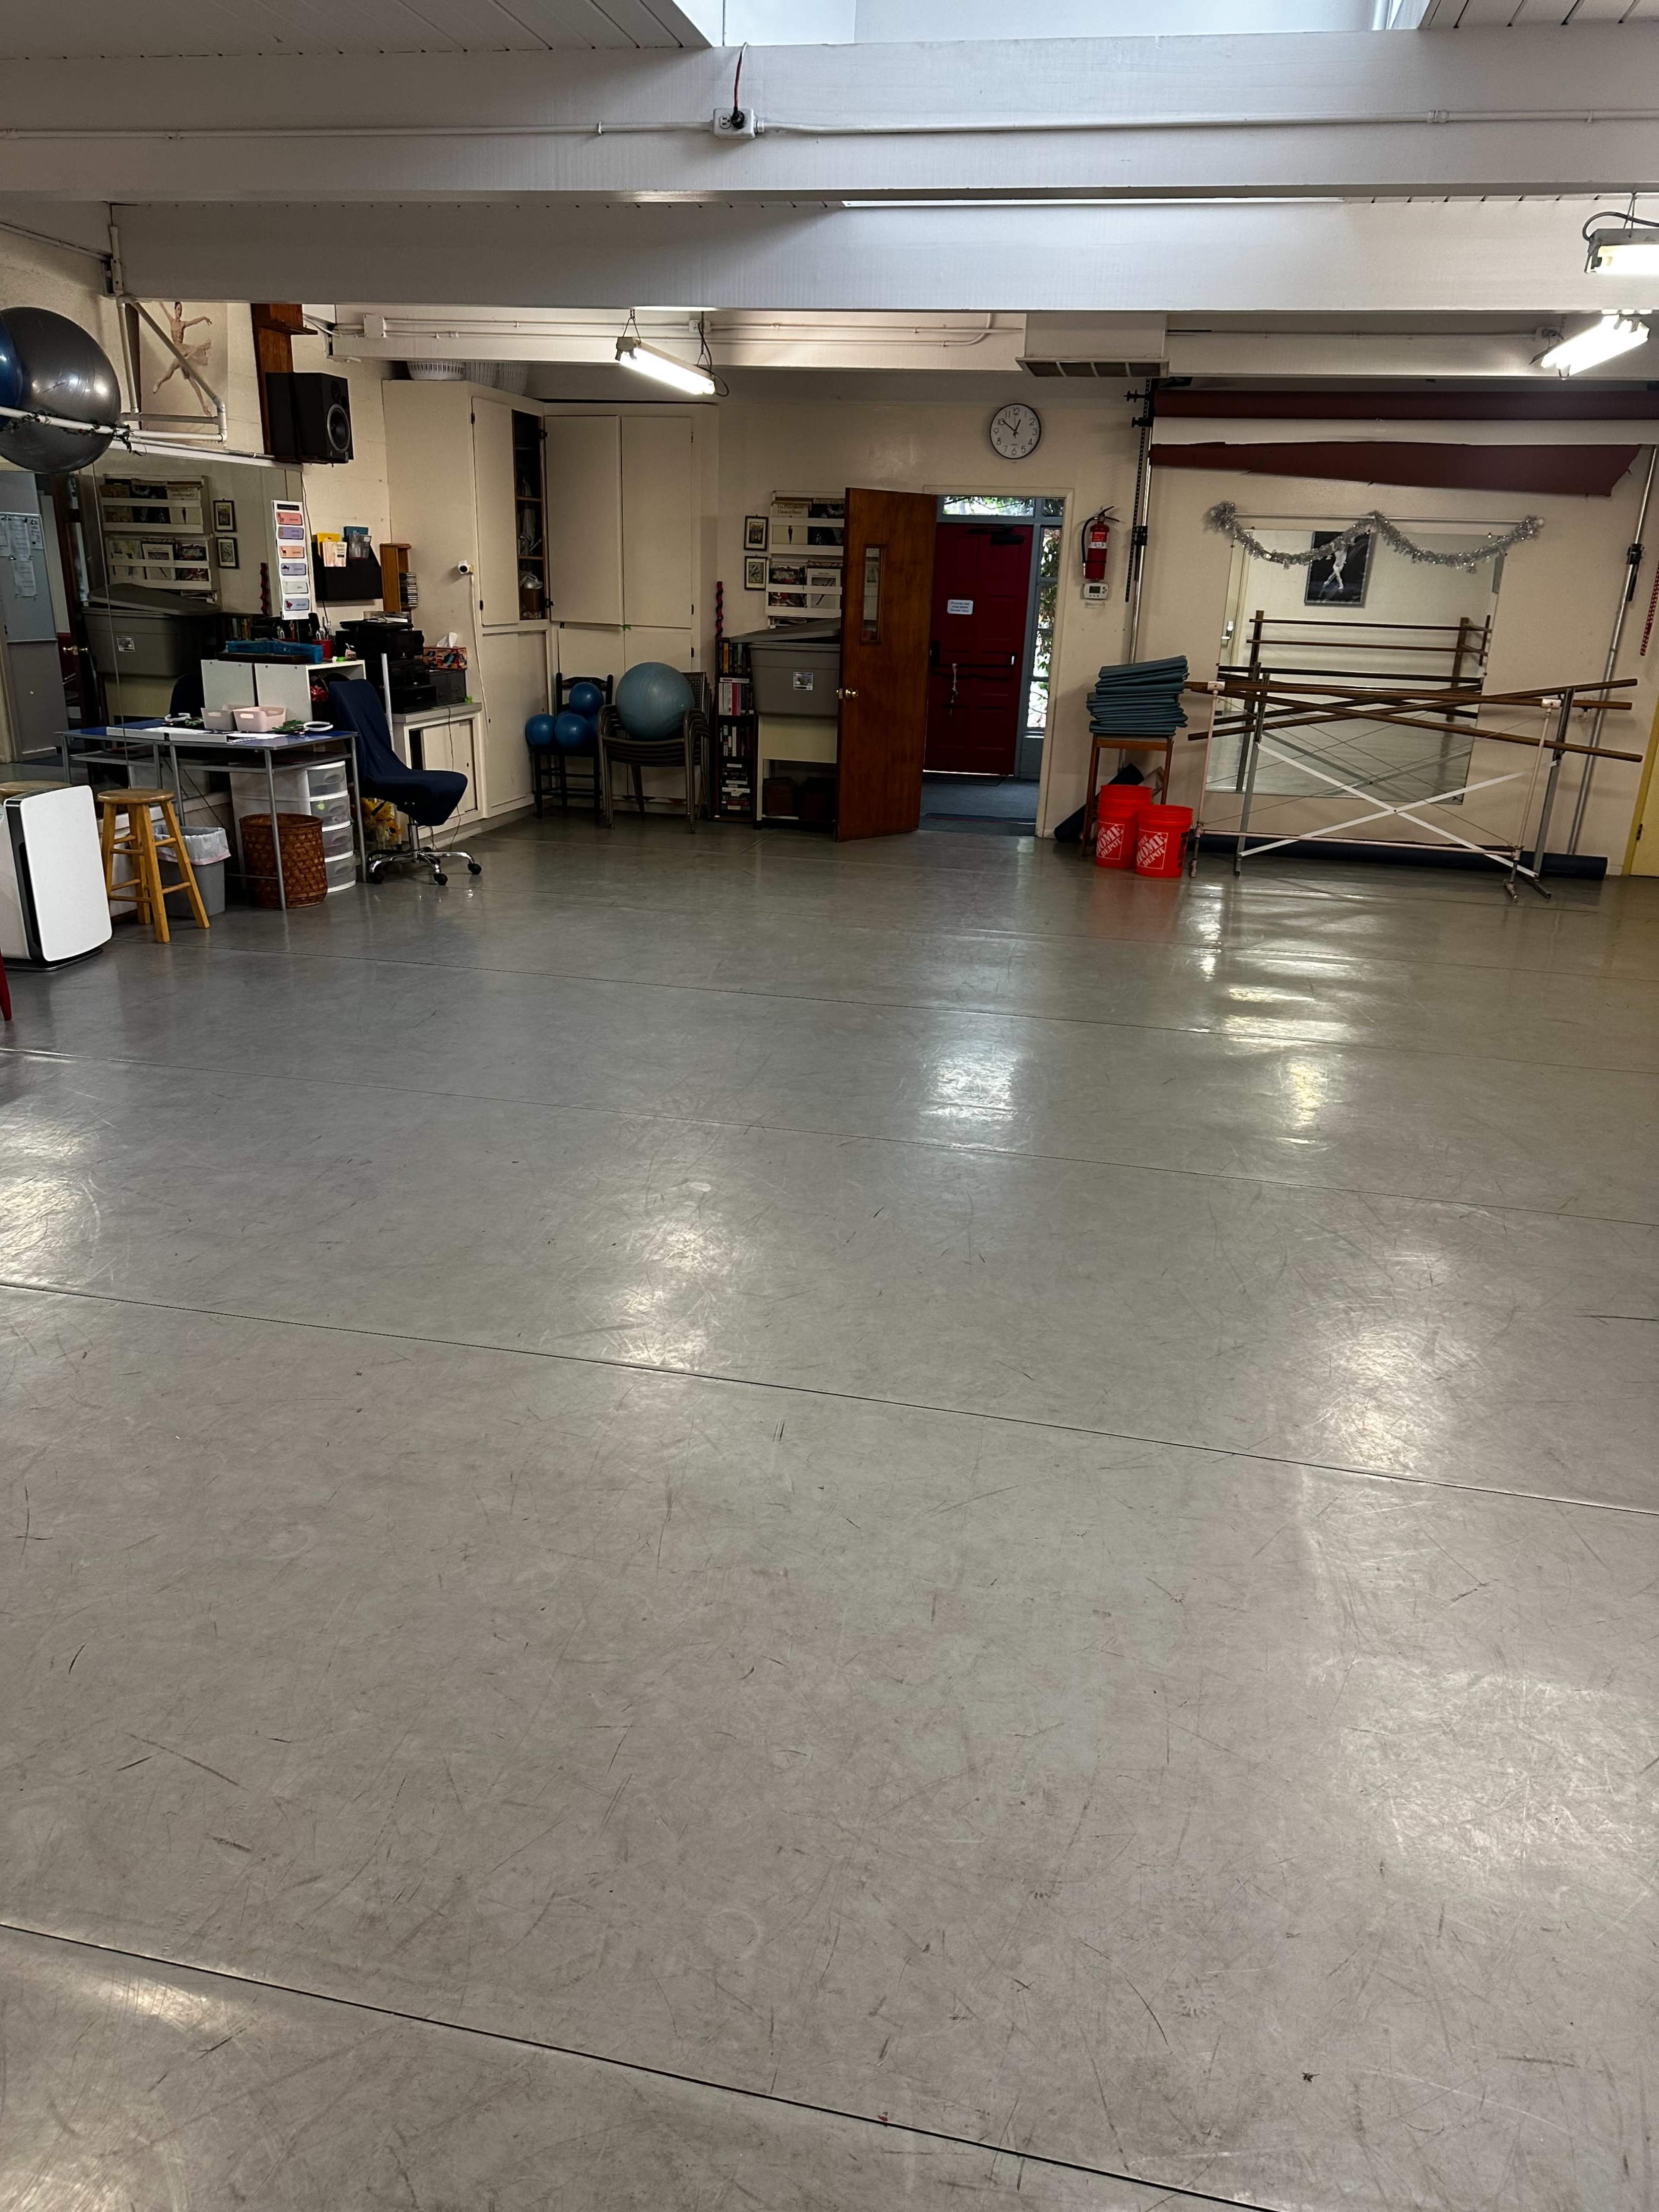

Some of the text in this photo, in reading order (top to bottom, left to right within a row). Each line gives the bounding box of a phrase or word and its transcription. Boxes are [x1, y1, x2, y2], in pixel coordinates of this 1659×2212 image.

[1013, 407, 1020, 416] 12
[1032, 428, 1037, 436] 3
[996, 437, 1001, 445] 8
[1011, 448, 1017, 456] 6
[1097, 826, 1107, 839] THE
[1096, 823, 1123, 856] HOME
[1138, 835, 1149, 847] THE
[1101, 837, 1122, 858] DEPOT
[1136, 832, 1167, 865] HOME
[1142, 846, 1166, 867] DEPOT
